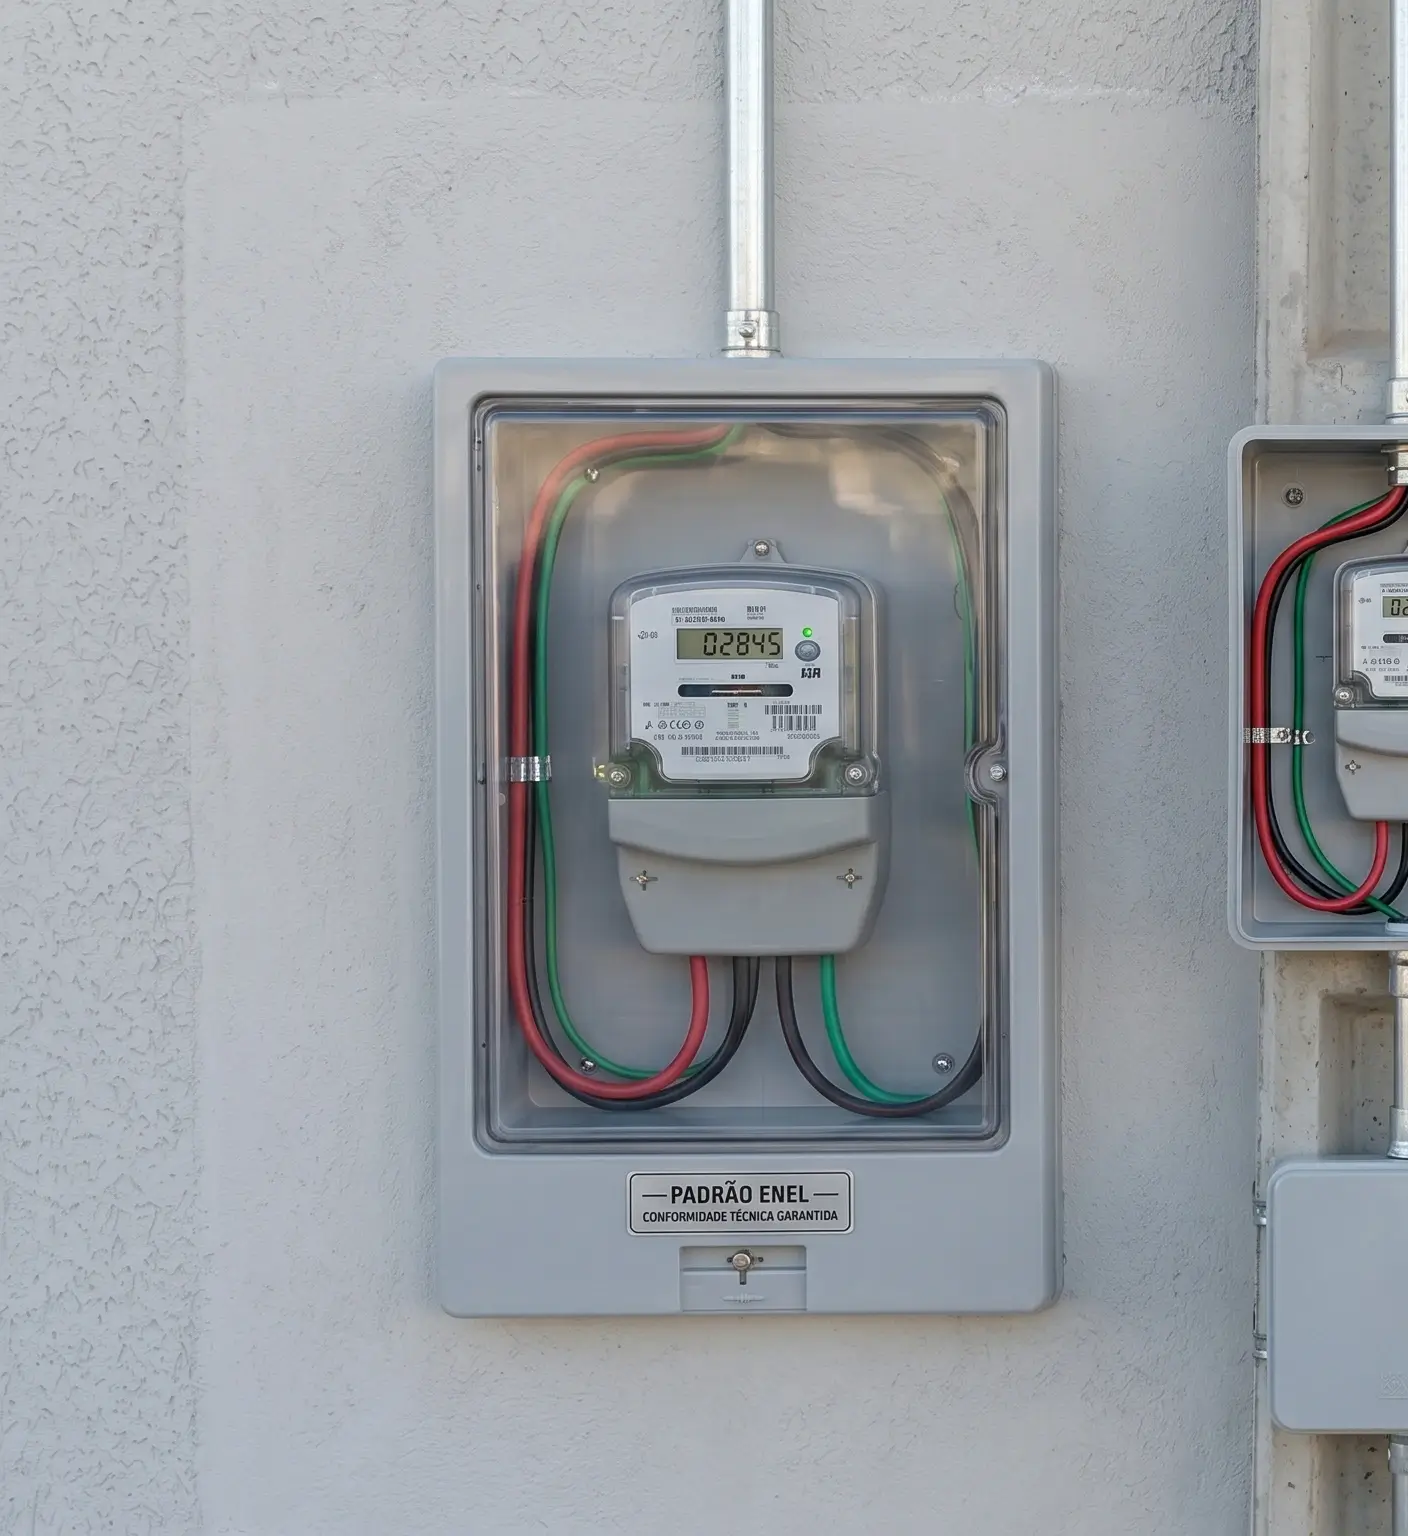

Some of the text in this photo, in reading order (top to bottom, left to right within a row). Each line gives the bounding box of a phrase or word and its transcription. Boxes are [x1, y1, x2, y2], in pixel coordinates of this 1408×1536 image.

[703, 632, 781, 656] 02845
[671, 1180, 809, 1204] PADRÃO ENEL
[643, 1209, 838, 1223] CONFORMIDADE TÉCNICA GARANTIDA
